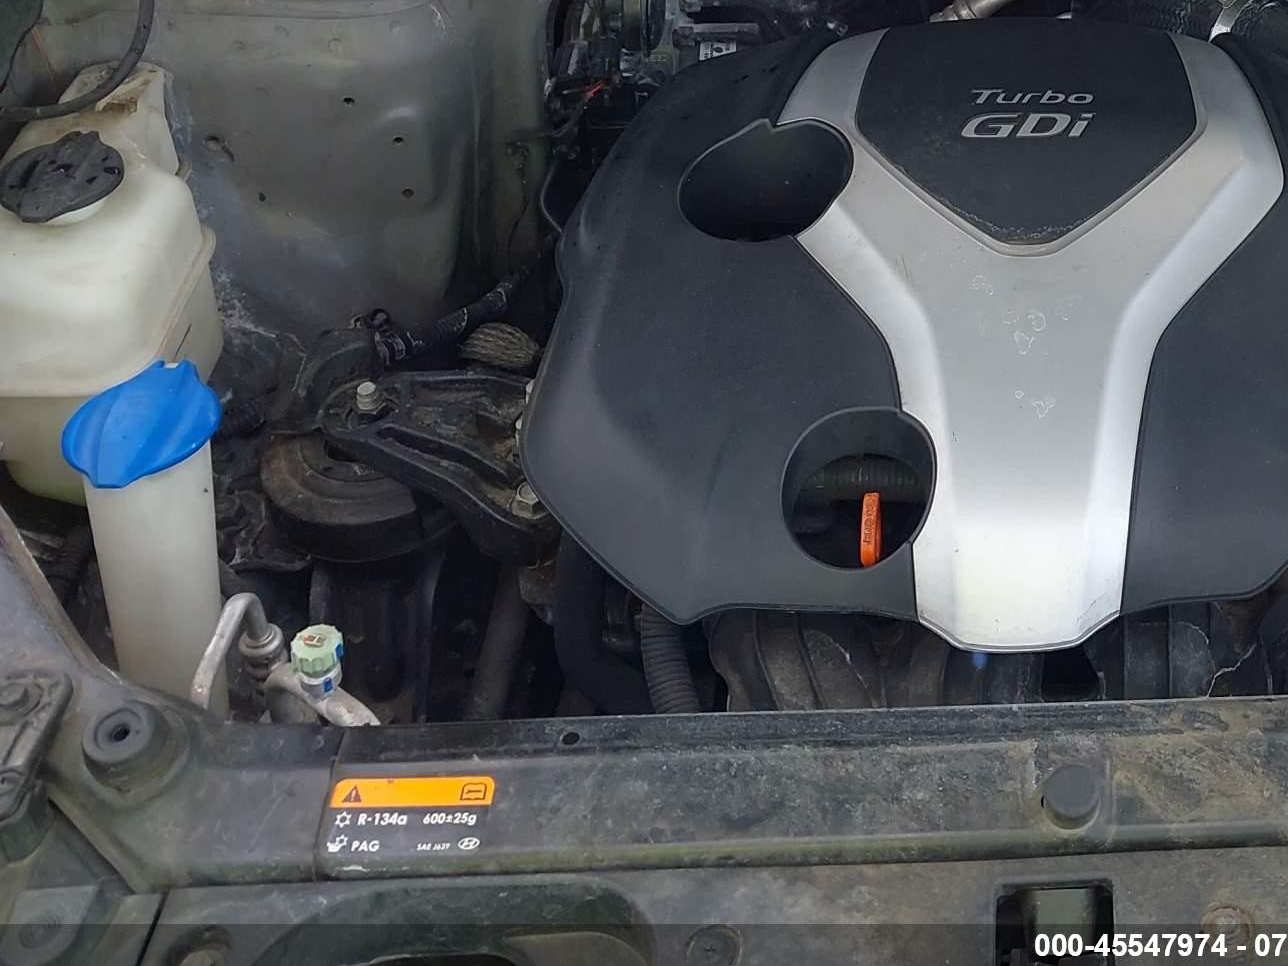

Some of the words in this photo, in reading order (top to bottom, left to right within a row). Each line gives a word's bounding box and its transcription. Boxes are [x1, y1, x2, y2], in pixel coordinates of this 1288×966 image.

[971, 89, 1095, 104] Turbo
[961, 112, 1096, 138] GDi
[357, 812, 408, 826] R-134a
[423, 812, 477, 826] 600±25g
[351, 840, 380, 852] PAG
